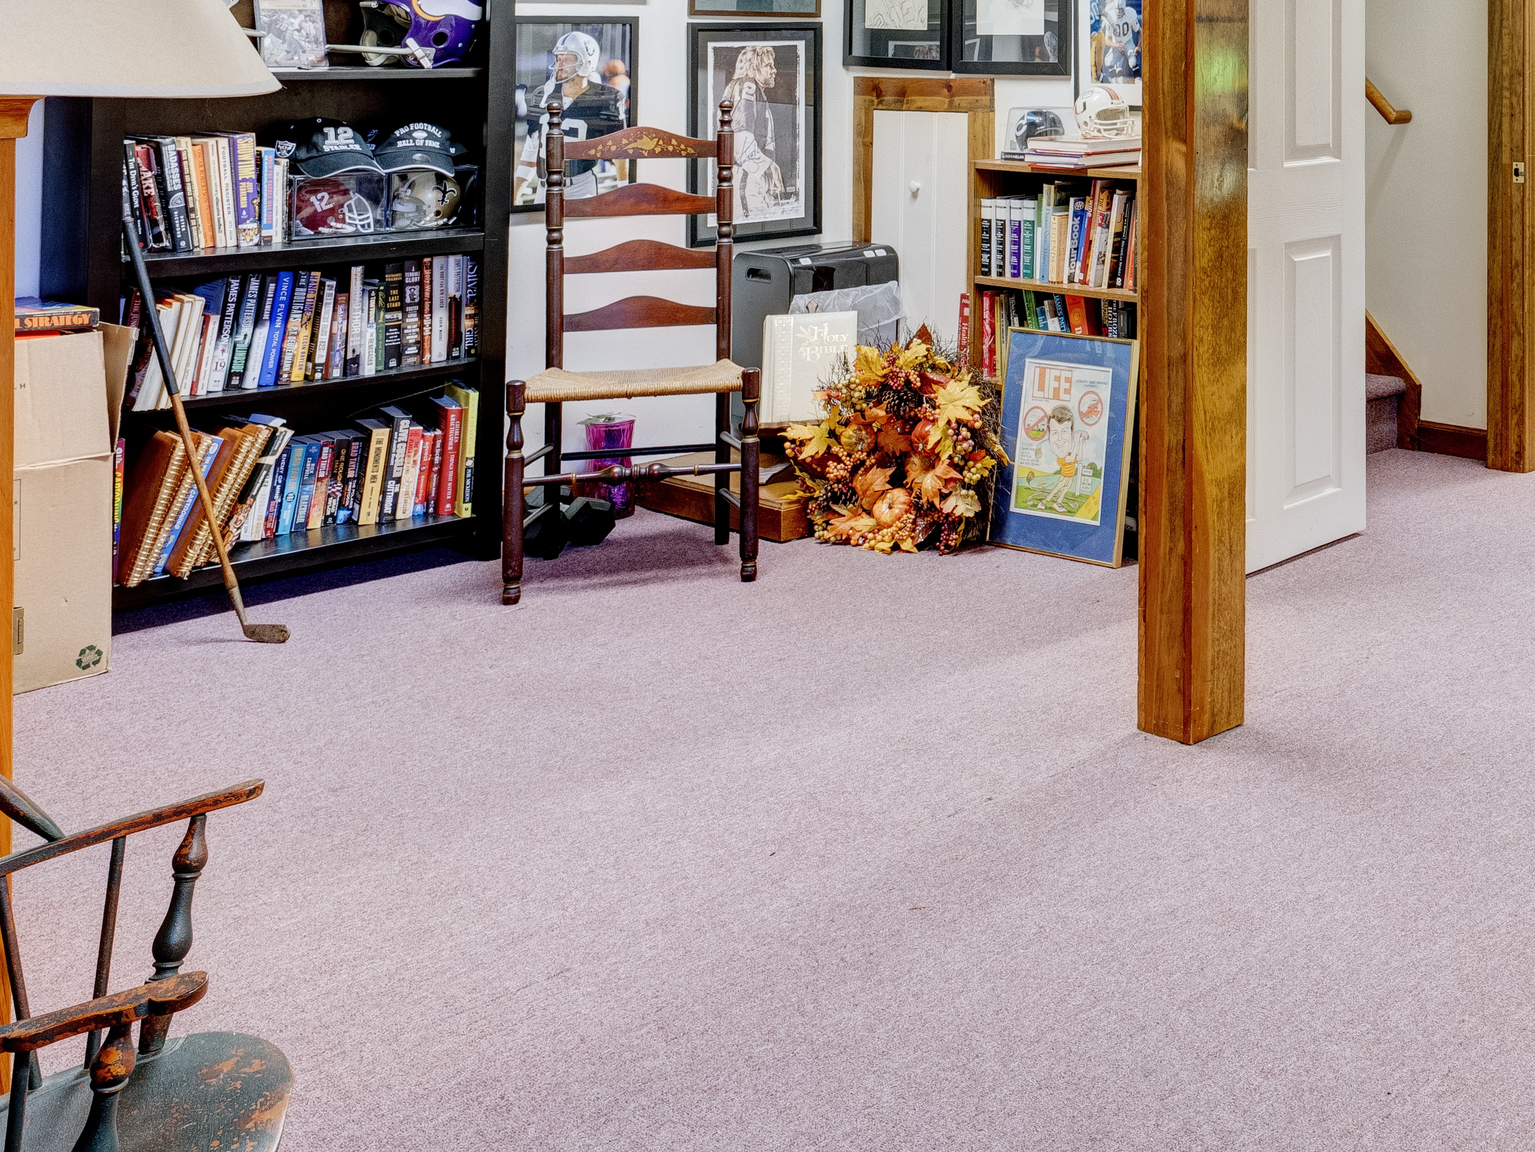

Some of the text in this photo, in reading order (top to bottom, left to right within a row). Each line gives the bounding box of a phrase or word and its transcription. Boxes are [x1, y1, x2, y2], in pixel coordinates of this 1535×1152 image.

[323, 126, 354, 144] 12
[394, 123, 442, 137] PRO FOOTBALL
[397, 139, 414, 148] HALL
[425, 139, 440, 148] FAME
[168, 144, 182, 190] BADASSES
[236, 137, 255, 179] SHOWTIME
[310, 192, 333, 212] 12
[279, 277, 290, 301] VINCE
[308, 275, 318, 294] HANG
[466, 264, 478, 298] Silva
[221, 278, 239, 345] JAMES PATTERSON
[242, 278, 259, 332] JAMES PATTERSON
[262, 298, 273, 320] KILMEADE
[274, 304, 284, 328] FLYNN
[290, 288, 306, 322] HOOLIGANS
[305, 296, 315, 314] TIME
[1054, 295, 1063, 316] JAMES
[24, 312, 91, 328] STRATEGY
[351, 311, 362, 334] THOR
[271, 331, 280, 348] TOTAL
[465, 328, 474, 350] GIRL
[231, 344, 247, 373] BLINDSIDE
[282, 336, 296, 371] DEUTERMANN
[298, 352, 306, 371] BAYLOR
[806, 344, 848, 362] BIBLE
[1033, 366, 1072, 400] LIFE
[347, 442, 359, 478] BRAD TAYLOR
[371, 446, 382, 473] MONUMENTS
[393, 419, 409, 478] CLIVE CUSSLER
[278, 475, 283, 484] OF
[288, 448, 303, 491] BRAD TAYLOR
[318, 460, 327, 478] TAYLOR
[369, 475, 378, 484] MEN
[384, 480, 394, 514] CUTTHROAT
[174, 488, 195, 530] CARTOONING
